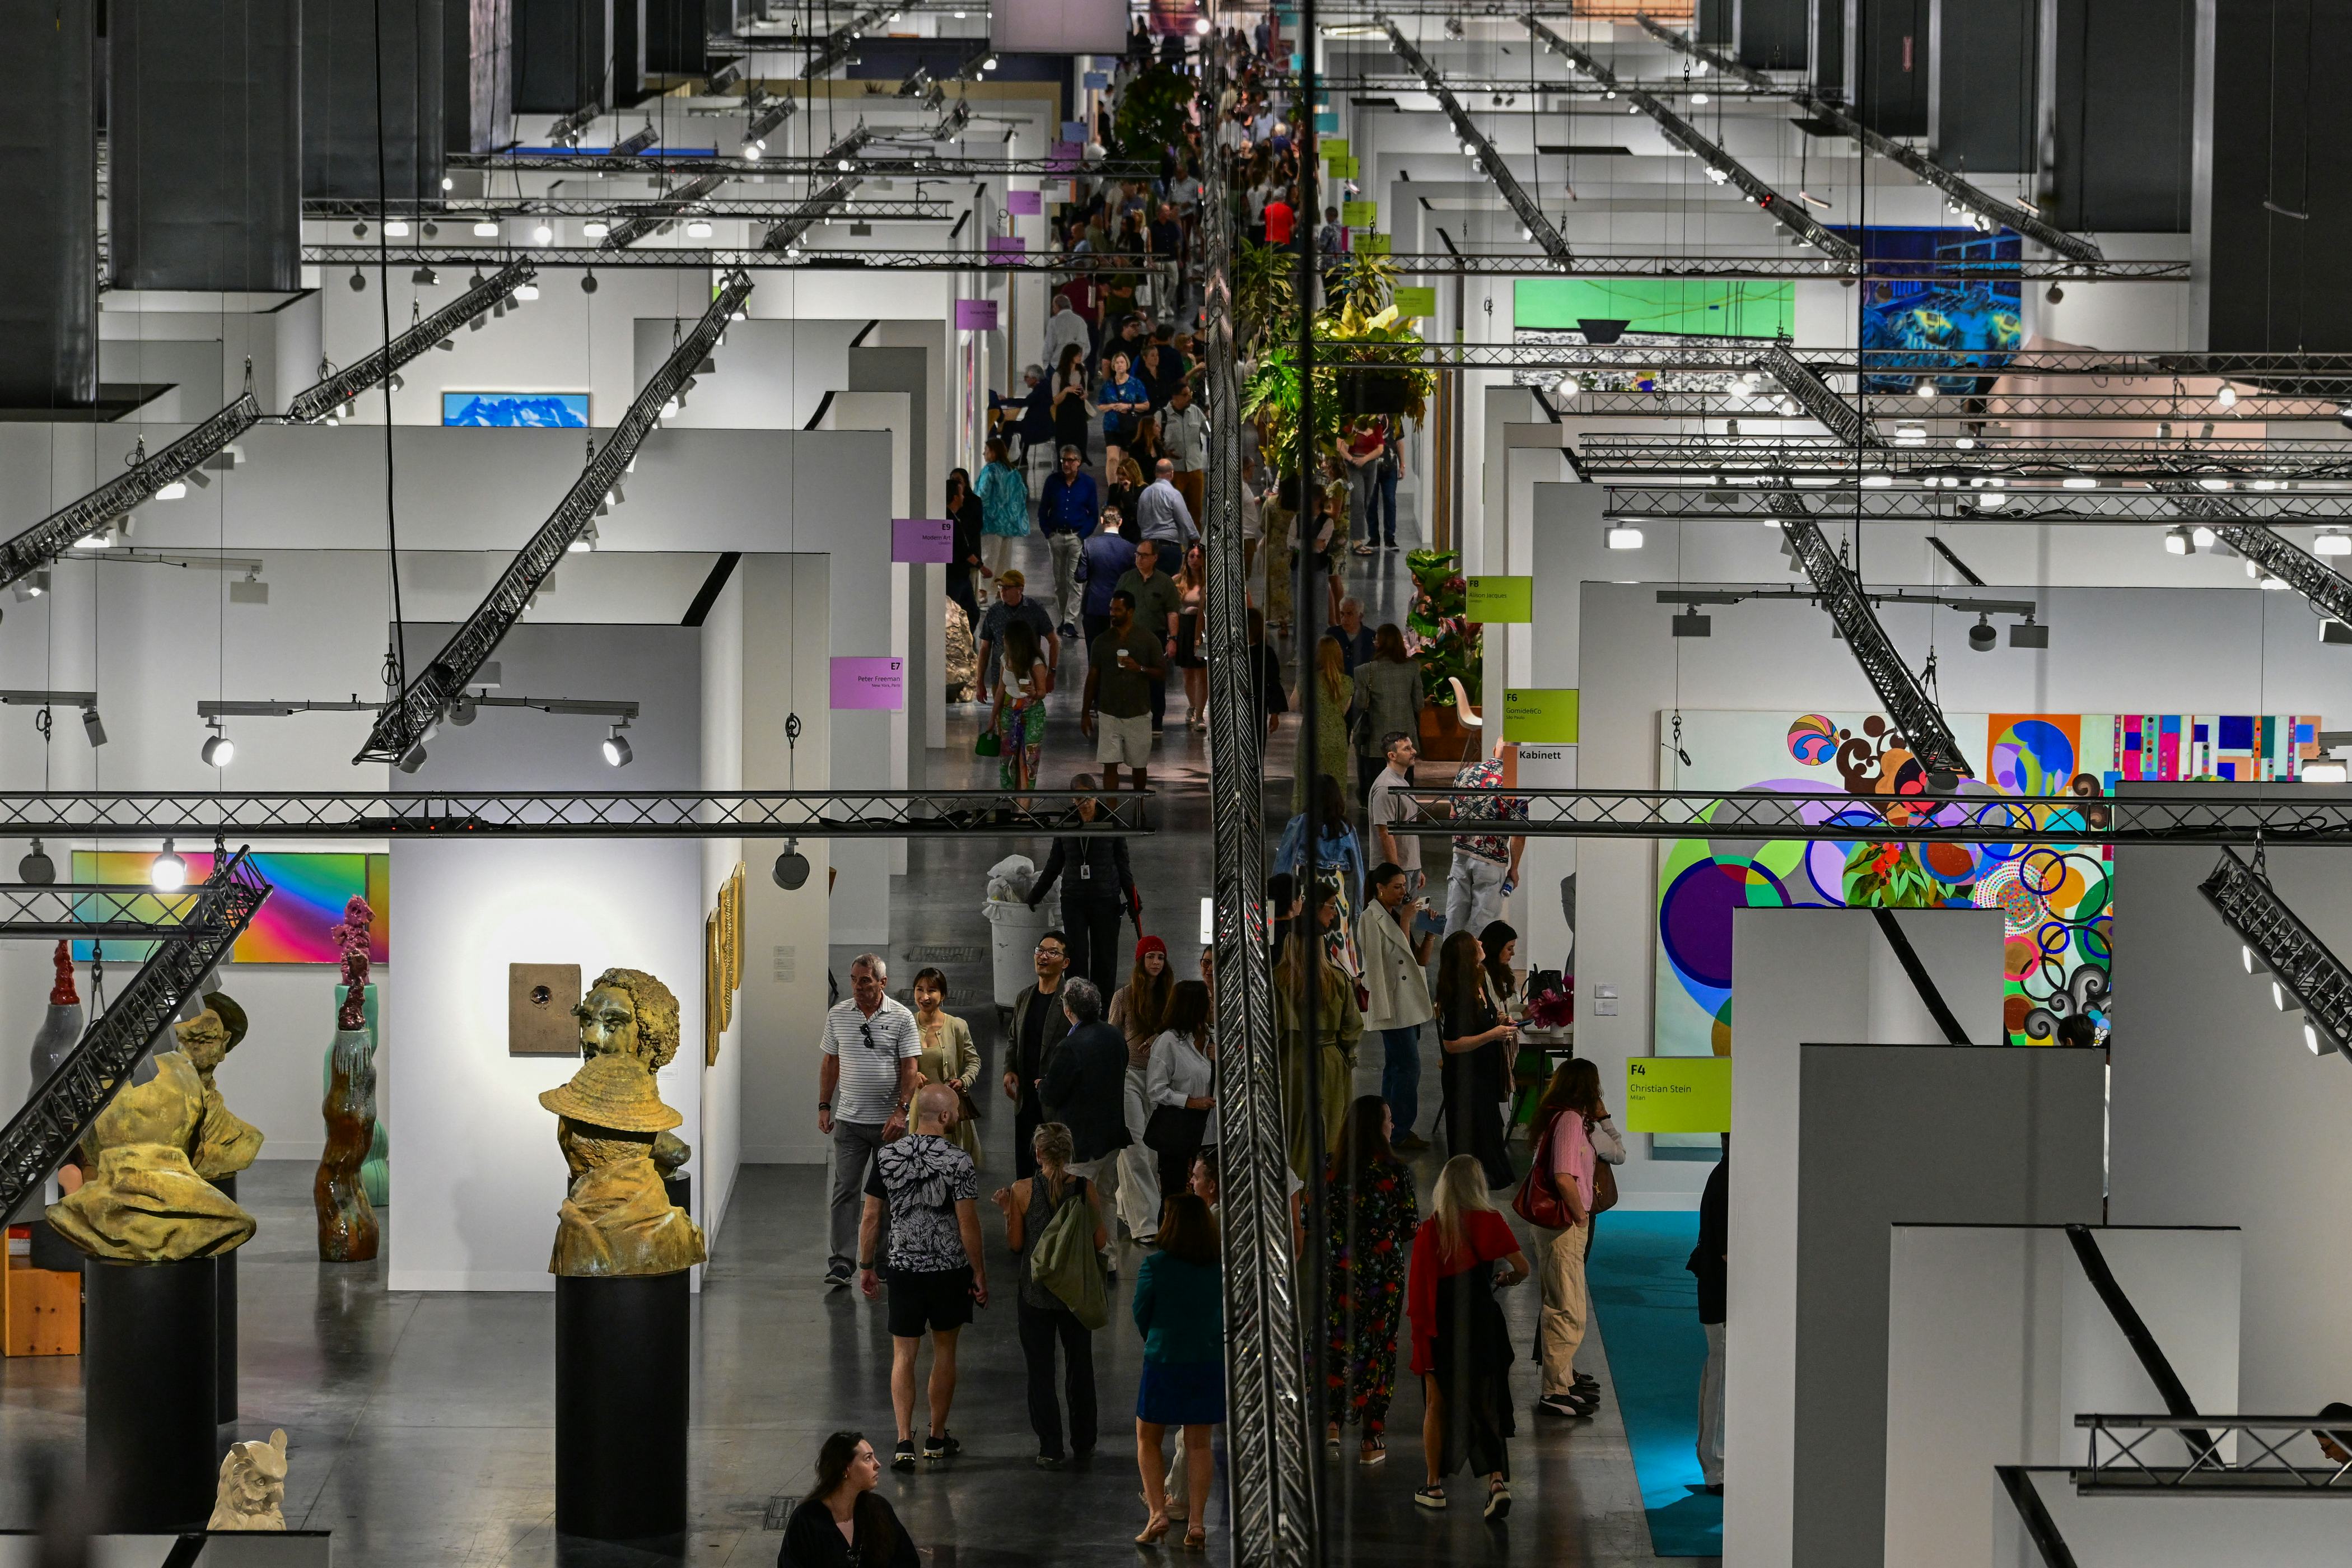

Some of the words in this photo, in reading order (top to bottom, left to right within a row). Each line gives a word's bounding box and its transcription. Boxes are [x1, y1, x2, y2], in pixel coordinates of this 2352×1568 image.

[1519, 751, 1561, 759] Kabinett
[1631, 1064, 1646, 1075] F4
[1630, 1084, 1668, 1093] Christian
